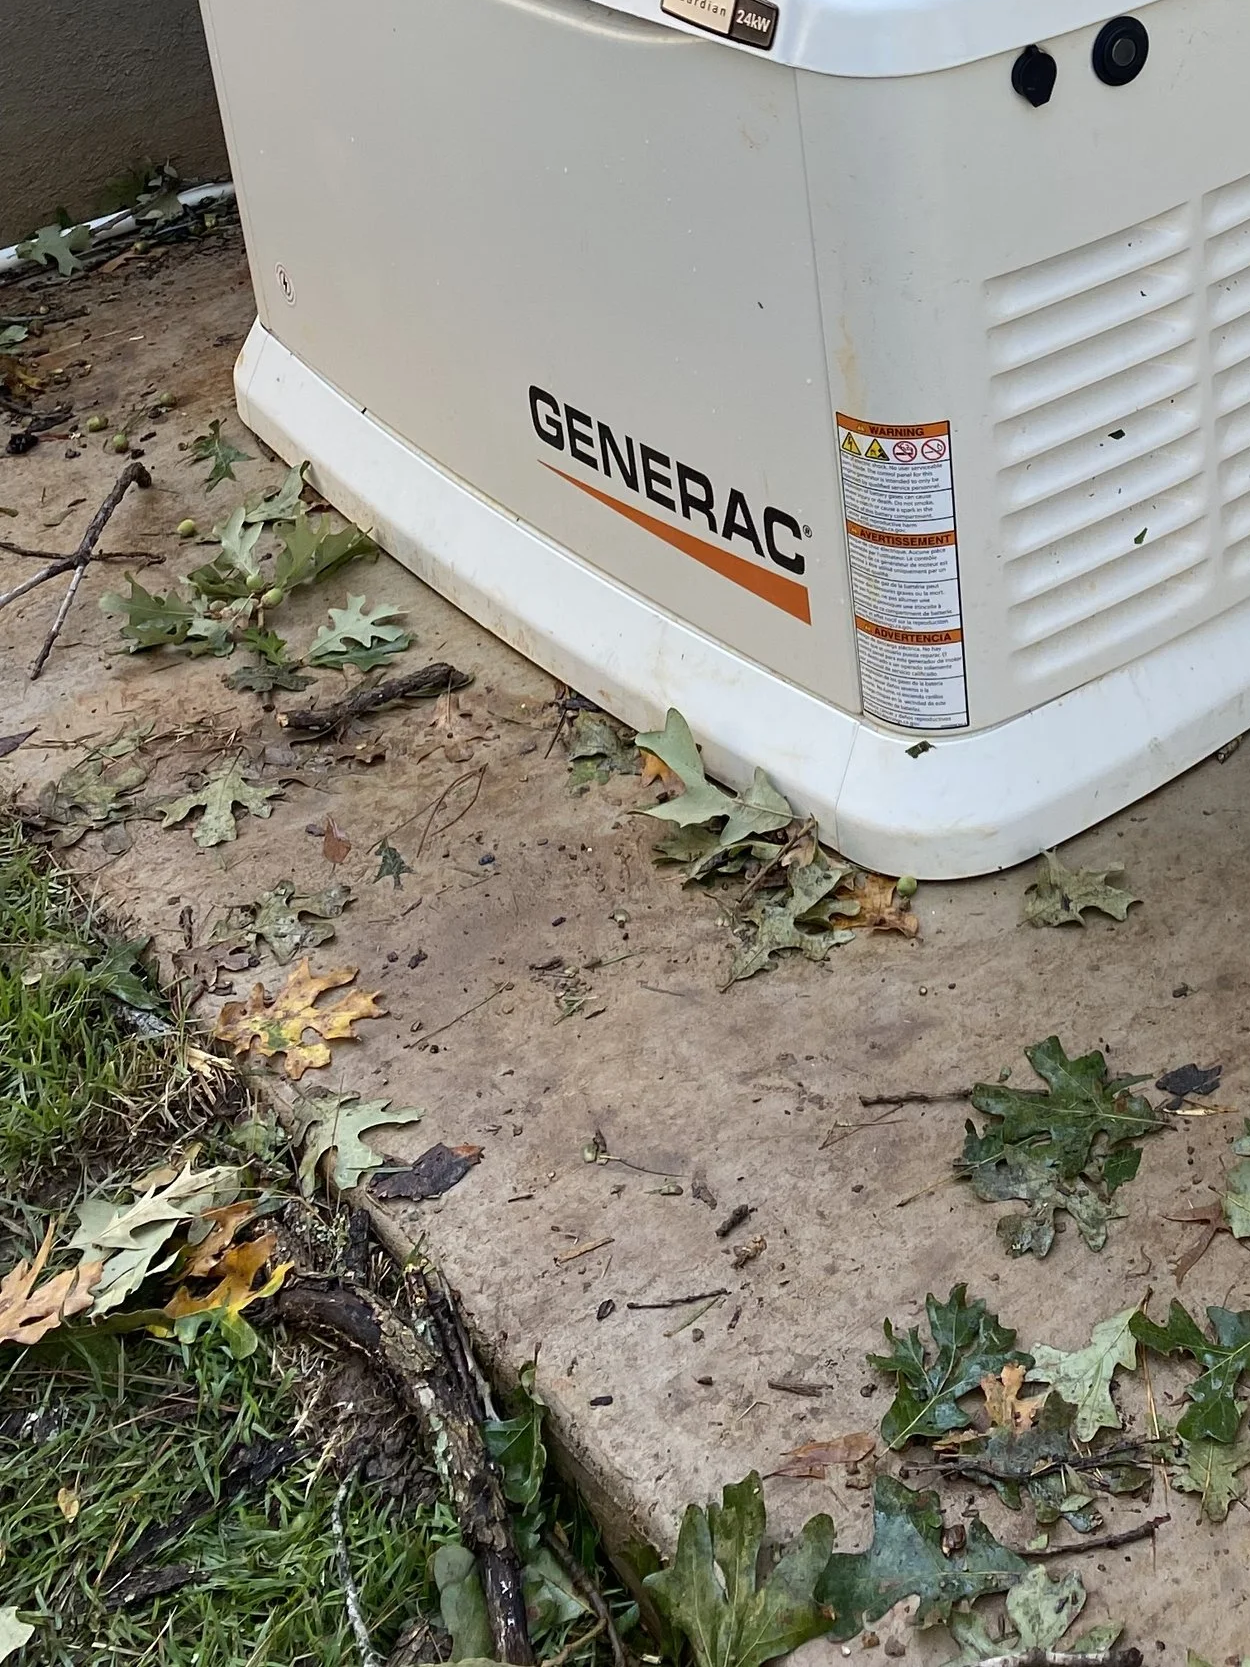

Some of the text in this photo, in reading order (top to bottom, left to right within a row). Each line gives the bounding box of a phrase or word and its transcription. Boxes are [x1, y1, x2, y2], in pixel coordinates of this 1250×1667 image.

[736, 10, 771, 33] 24kW
[868, 425, 924, 437] WARNING
[528, 385, 806, 576] GENERAC
[860, 530, 952, 546] AVERTISSEMENT
[874, 628, 952, 644] ADVERTENCIA
